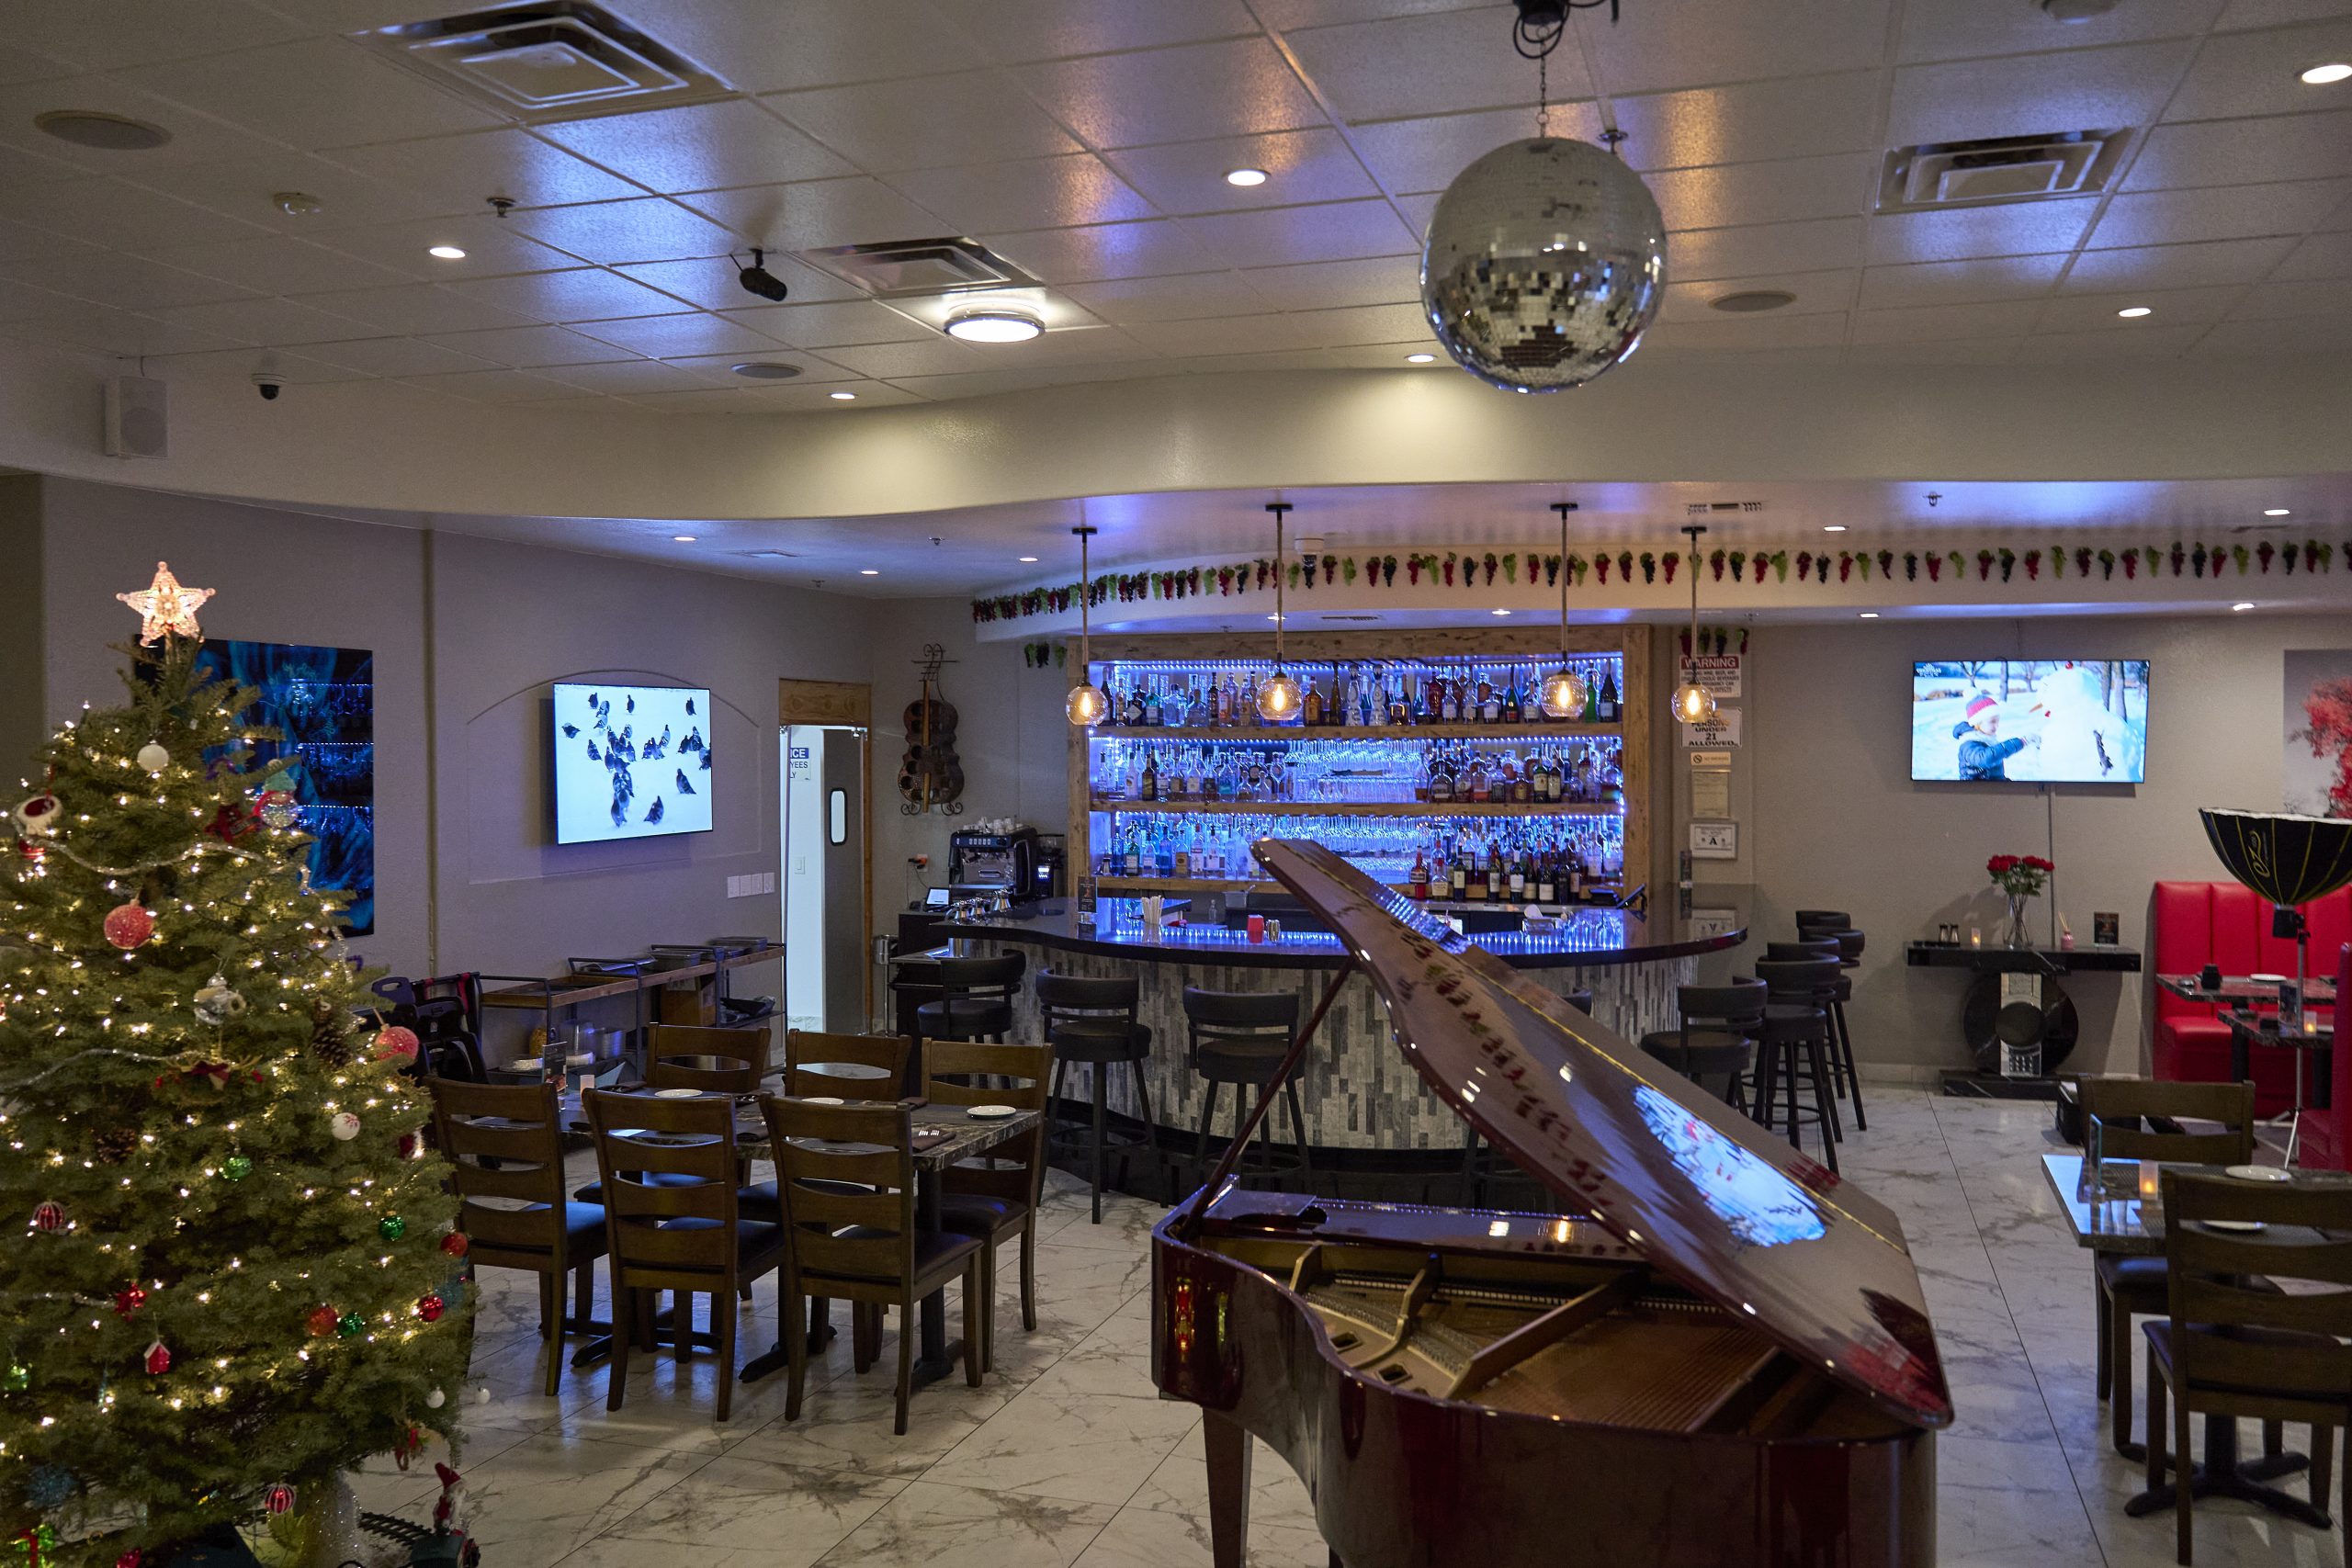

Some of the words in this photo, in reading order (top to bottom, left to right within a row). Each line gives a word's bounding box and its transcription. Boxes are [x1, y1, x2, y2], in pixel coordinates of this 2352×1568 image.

[1685, 658, 1736, 668] WARNING
[1705, 732, 1717, 740] 21
[1709, 837, 1718, 845] A
